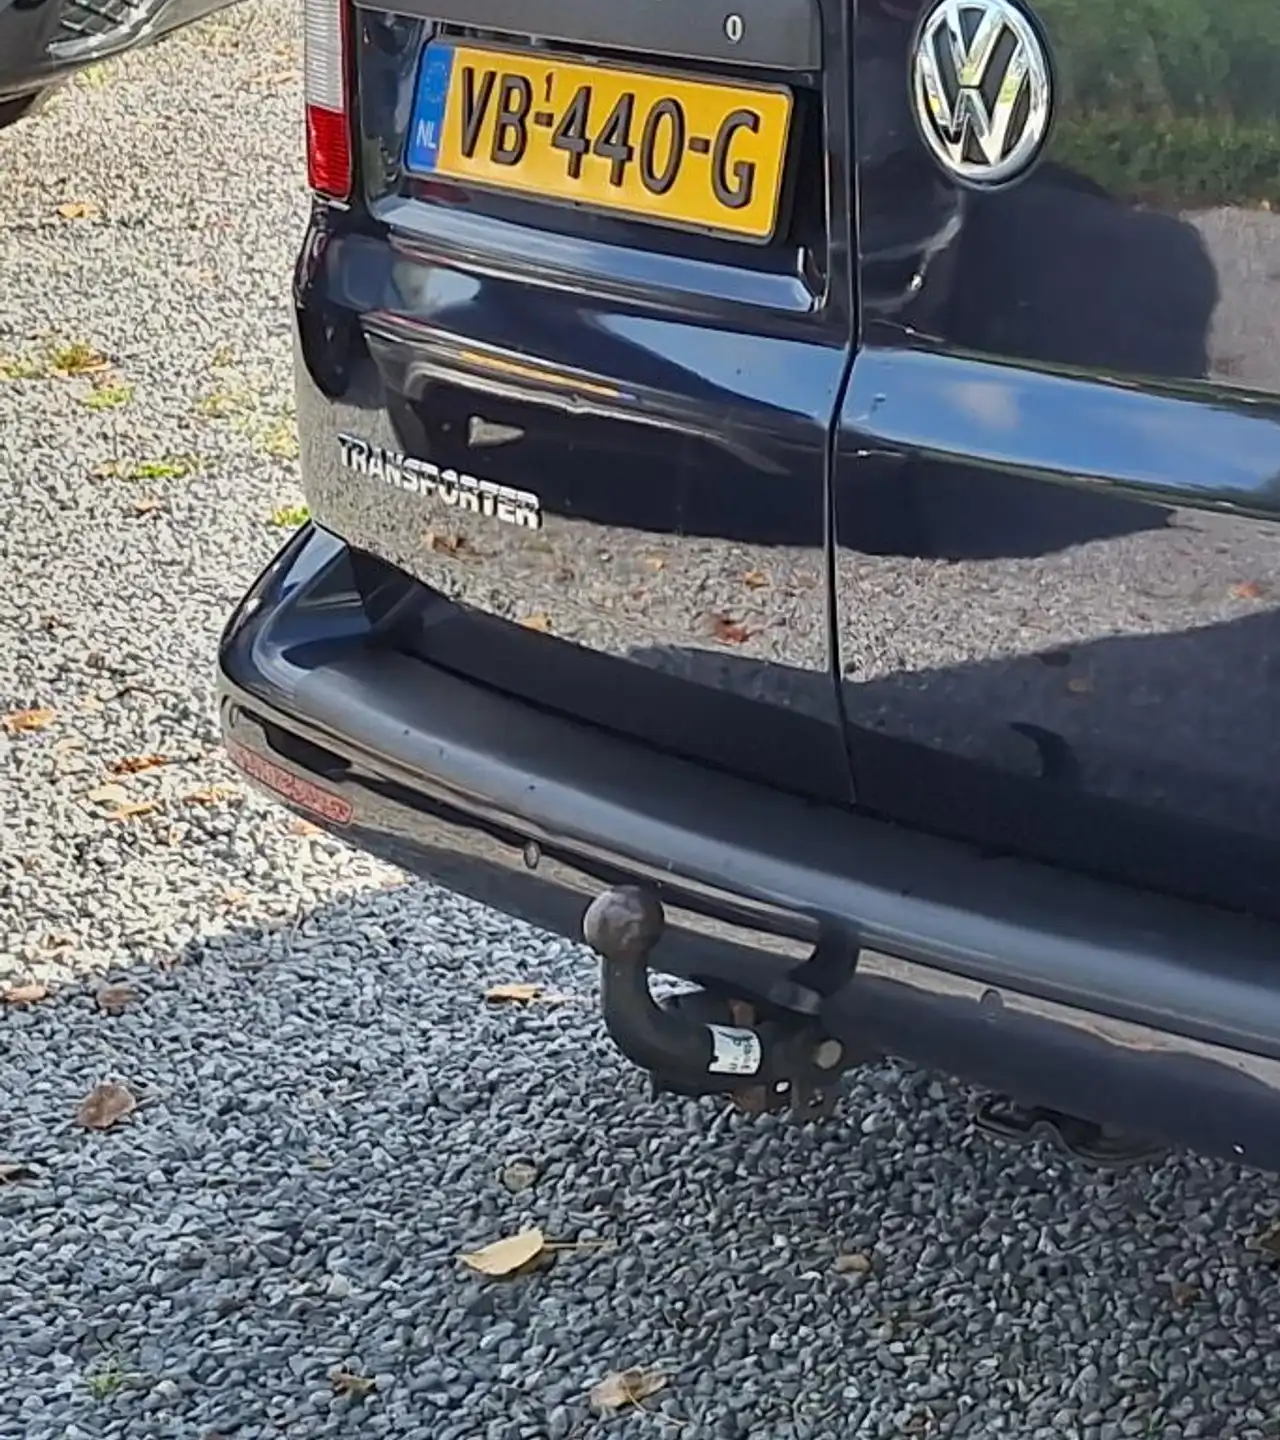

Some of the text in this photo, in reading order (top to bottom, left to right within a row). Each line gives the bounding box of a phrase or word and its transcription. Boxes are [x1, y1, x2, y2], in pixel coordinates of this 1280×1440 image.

[416, 119, 437, 150] NL
[461, 66, 761, 210] VB-440-G
[336, 432, 542, 531] TRANSPORTER
